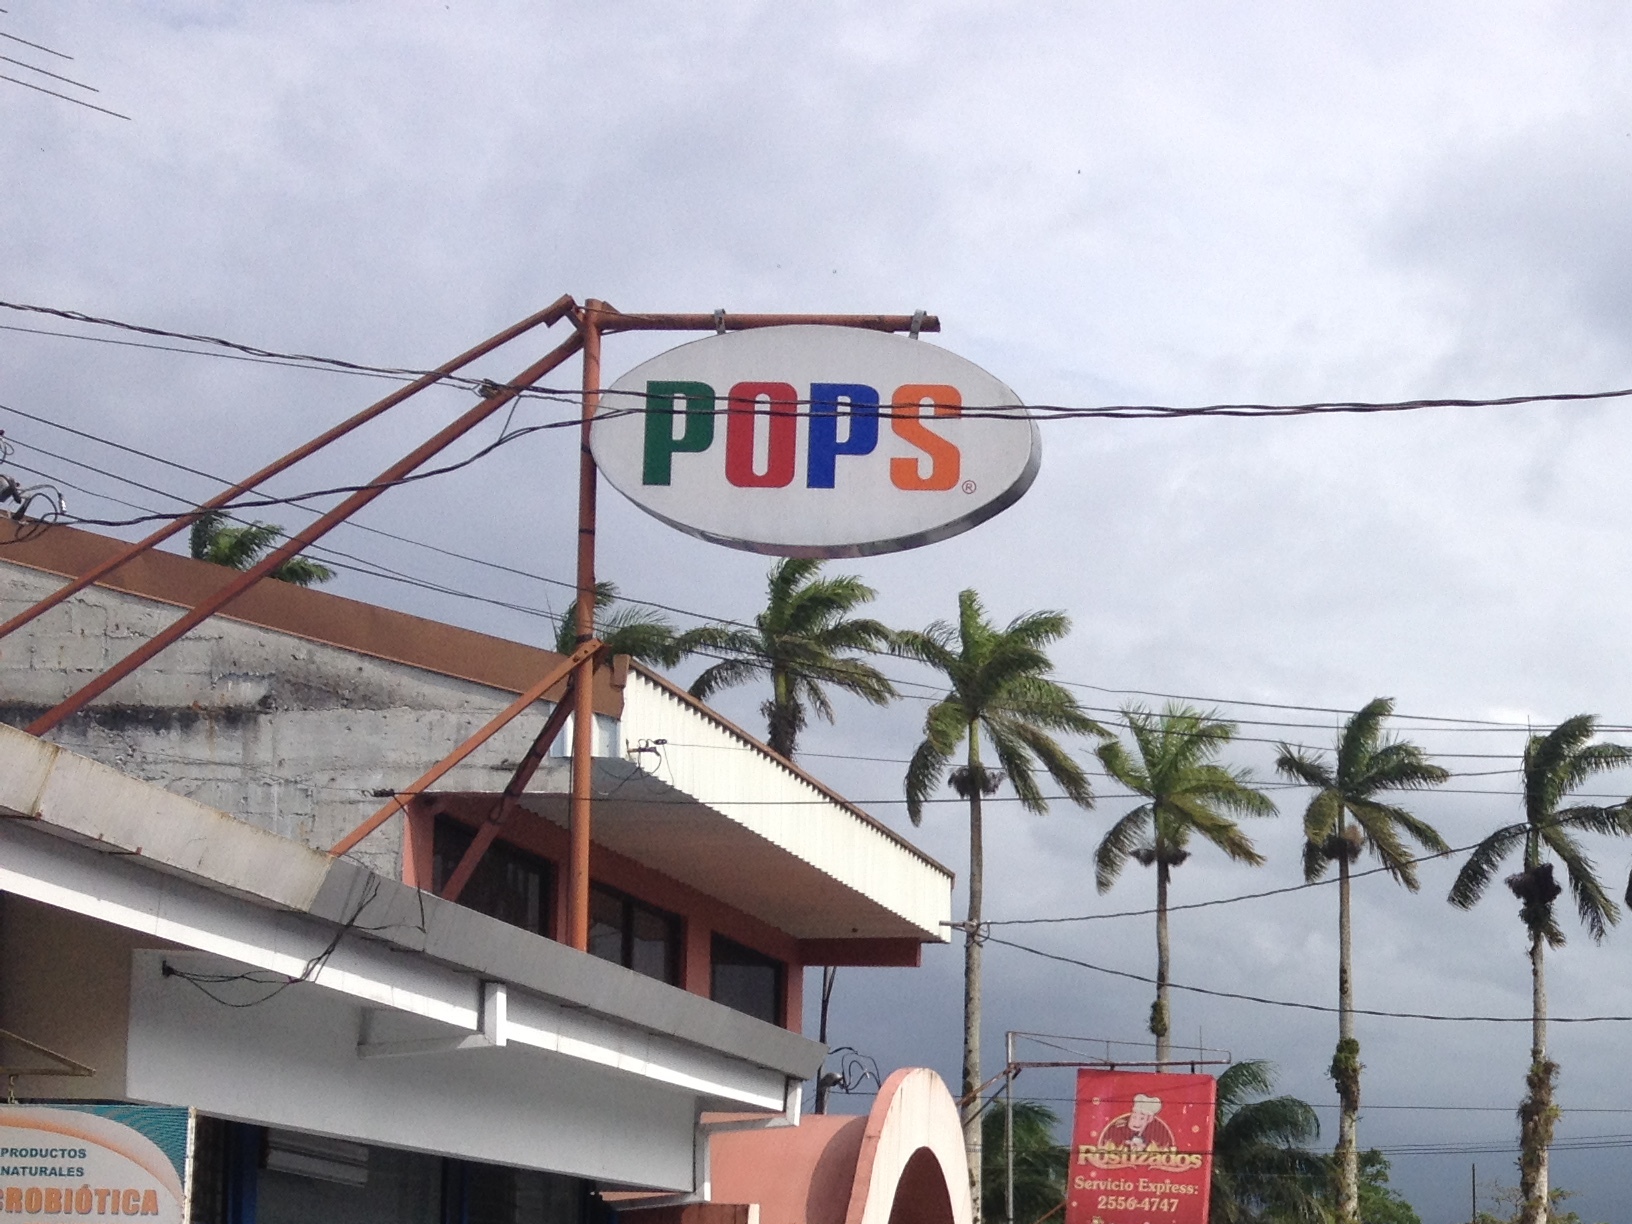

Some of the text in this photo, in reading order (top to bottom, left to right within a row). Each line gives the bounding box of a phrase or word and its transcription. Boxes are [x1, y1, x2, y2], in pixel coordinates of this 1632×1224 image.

[642, 381, 962, 491] POPS
[1, 1148, 87, 1159] PRODUCTOS
[1077, 1144, 1203, 1169] Rostizados
[1, 1166, 85, 1177] NATURALES
[1074, 1176, 1199, 1195] Servicio Express:
[0, 1184, 158, 1216] ROBIÓTICA
[1097, 1196, 1179, 1212] 2556-4747
